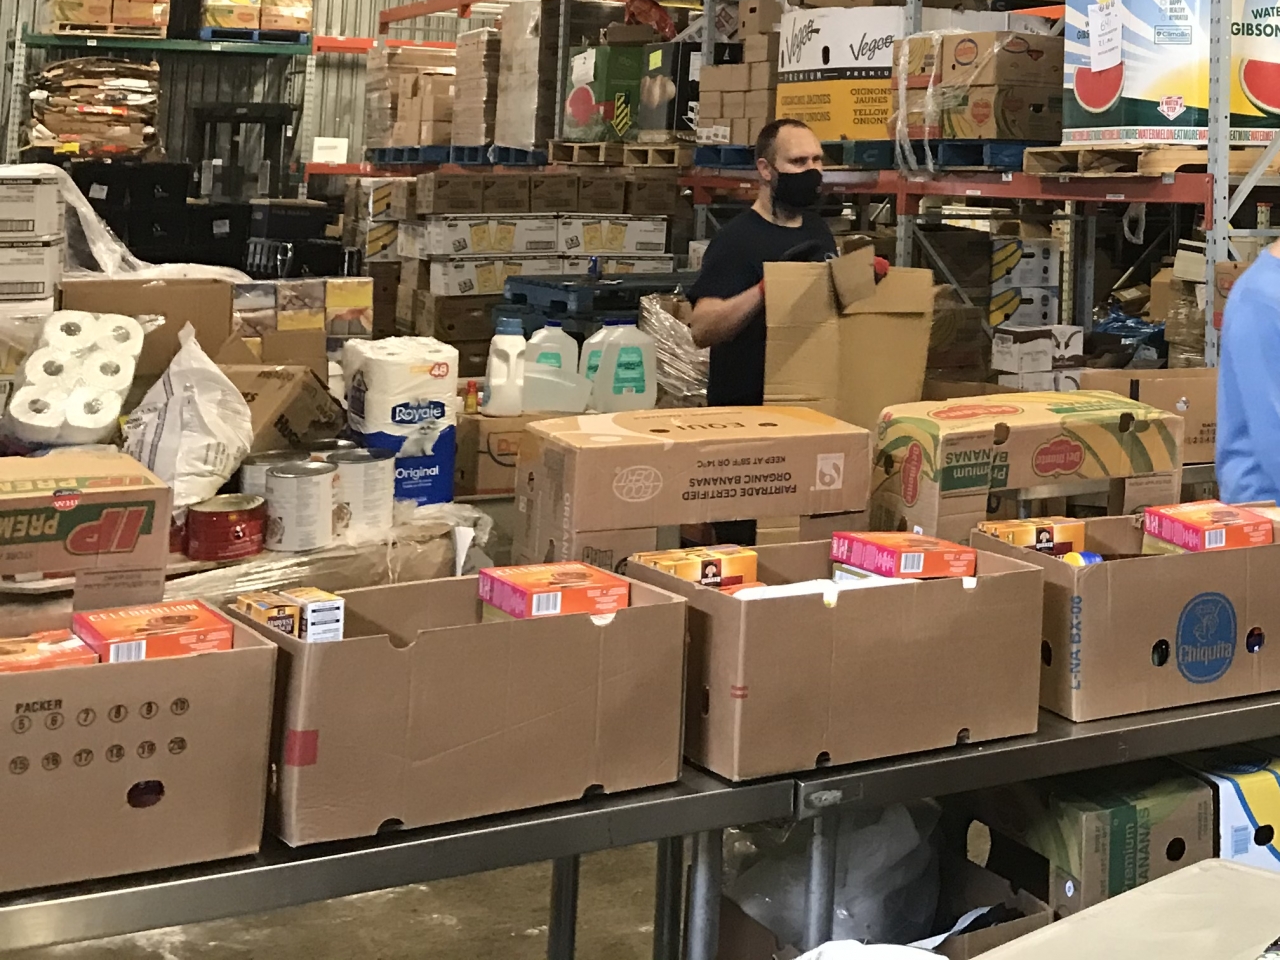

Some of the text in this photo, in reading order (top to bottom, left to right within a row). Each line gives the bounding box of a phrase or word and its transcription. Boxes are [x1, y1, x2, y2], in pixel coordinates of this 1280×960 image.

[850, 88, 892, 96] OIGNONS
[854, 96, 888, 104] JAUNES
[853, 109, 889, 117] YELLOW
[853, 117, 888, 125] ONIONS
[431, 363, 447, 377] 48
[396, 405, 442, 422] Royale
[717, 458, 729, 467] OR
[752, 456, 764, 465] AT
[765, 455, 787, 465] KEEP
[396, 465, 440, 481] Original
[621, 469, 655, 481] CERT
[689, 471, 792, 488] ORGANIC BANANAS
[953, 466, 1007, 480] Prmium
[623, 483, 651, 497] ECO
[682, 484, 797, 501] FAIRTRADE CERTIFIED
[561, 493, 571, 561] ORGANI
[88, 602, 200, 623] CELEBRATION
[1070, 595, 1082, 645] BX-06
[1178, 641, 1233, 666] Chiquita
[15, 698, 62, 714] PACKER
[1136, 806, 1150, 883] ANANAS
